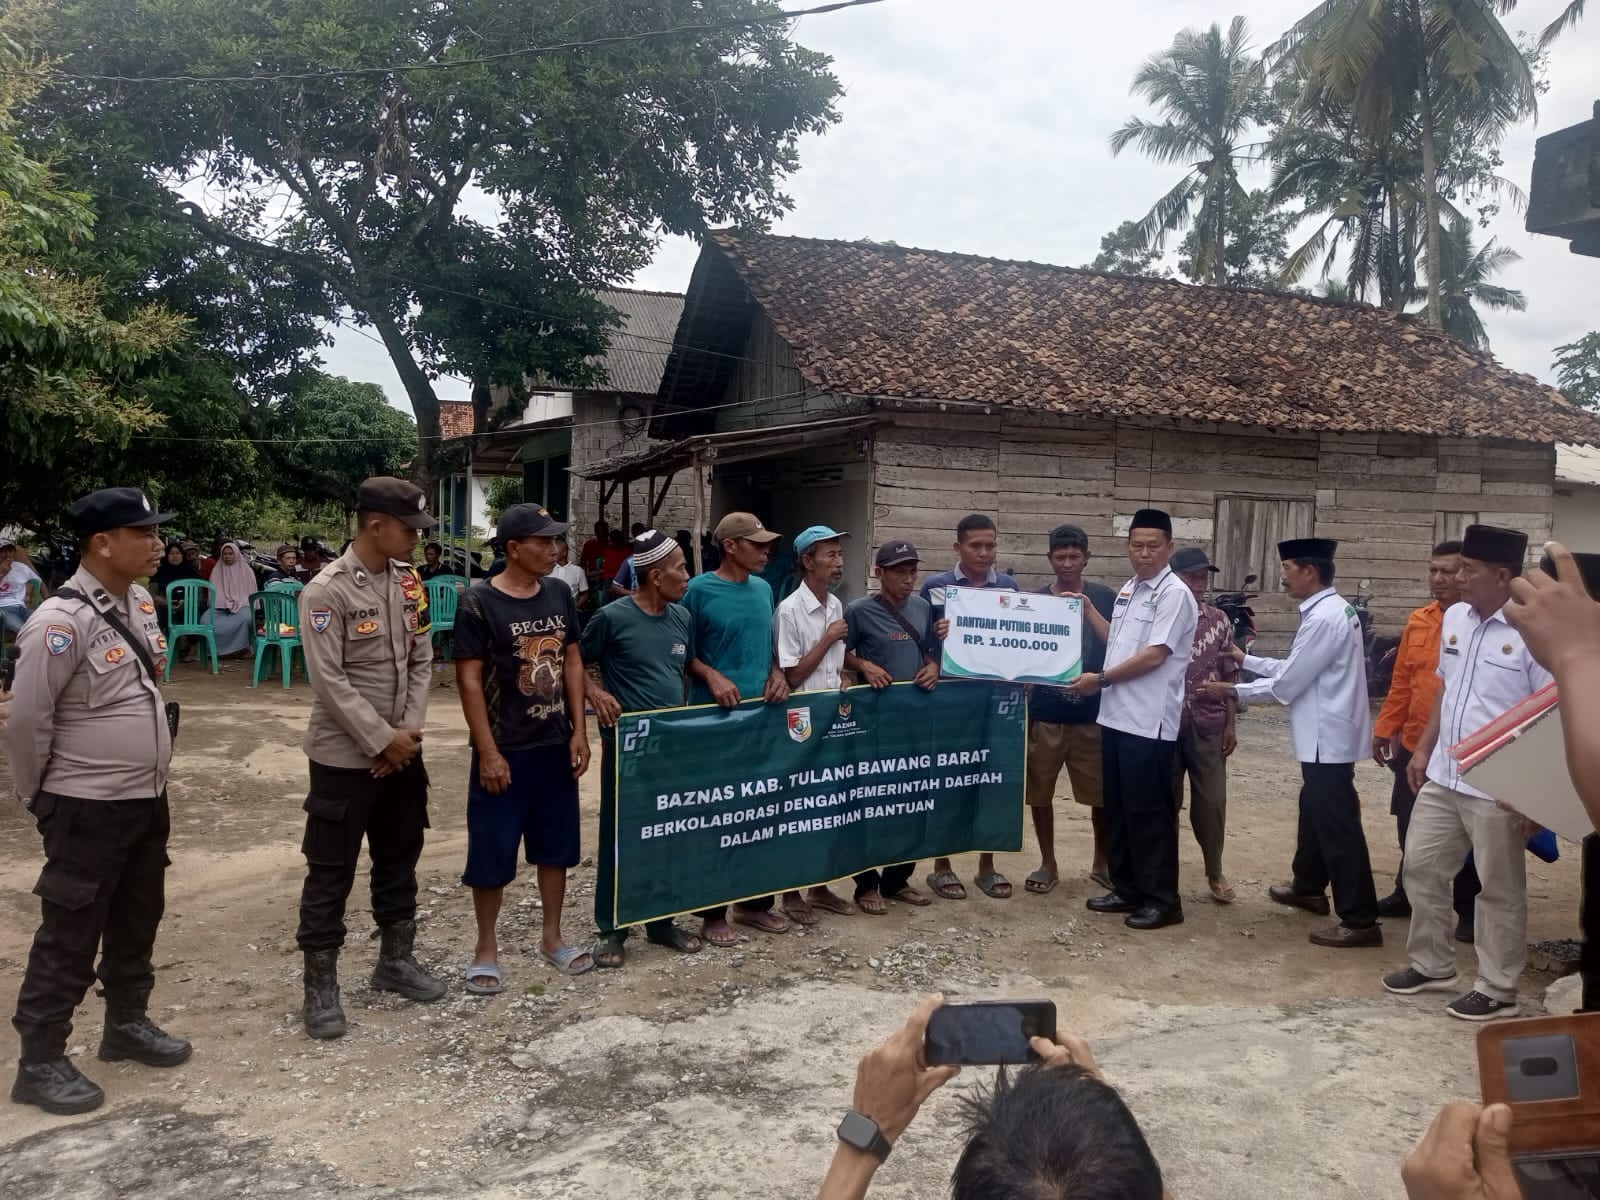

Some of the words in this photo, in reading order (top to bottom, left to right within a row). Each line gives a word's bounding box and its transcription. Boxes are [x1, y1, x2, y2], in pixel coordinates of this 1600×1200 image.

[510, 615, 566, 636] BECAK
[956, 616, 997, 630] BANTUAN
[999, 619, 1031, 632] PUTING
[963, 634, 985, 646] RP.
[989, 637, 1058, 651] 1.000.000
[656, 785, 735, 811] BAZNAS
[740, 777, 783, 798] KAB.
[789, 763, 854, 788] TULANG
[858, 755, 931, 776] BAWANG
[936, 749, 990, 767] BARAT
[640, 802, 779, 840] BERKOLABORASI
[783, 791, 847, 813] DENGAN
[849, 778, 940, 801] PEMERINTAH
[944, 772, 1003, 789] DAERAH
[720, 826, 774, 848] DALAM
[778, 809, 861, 836] PEMBERIAN
[864, 799, 935, 819] BANTUAN
